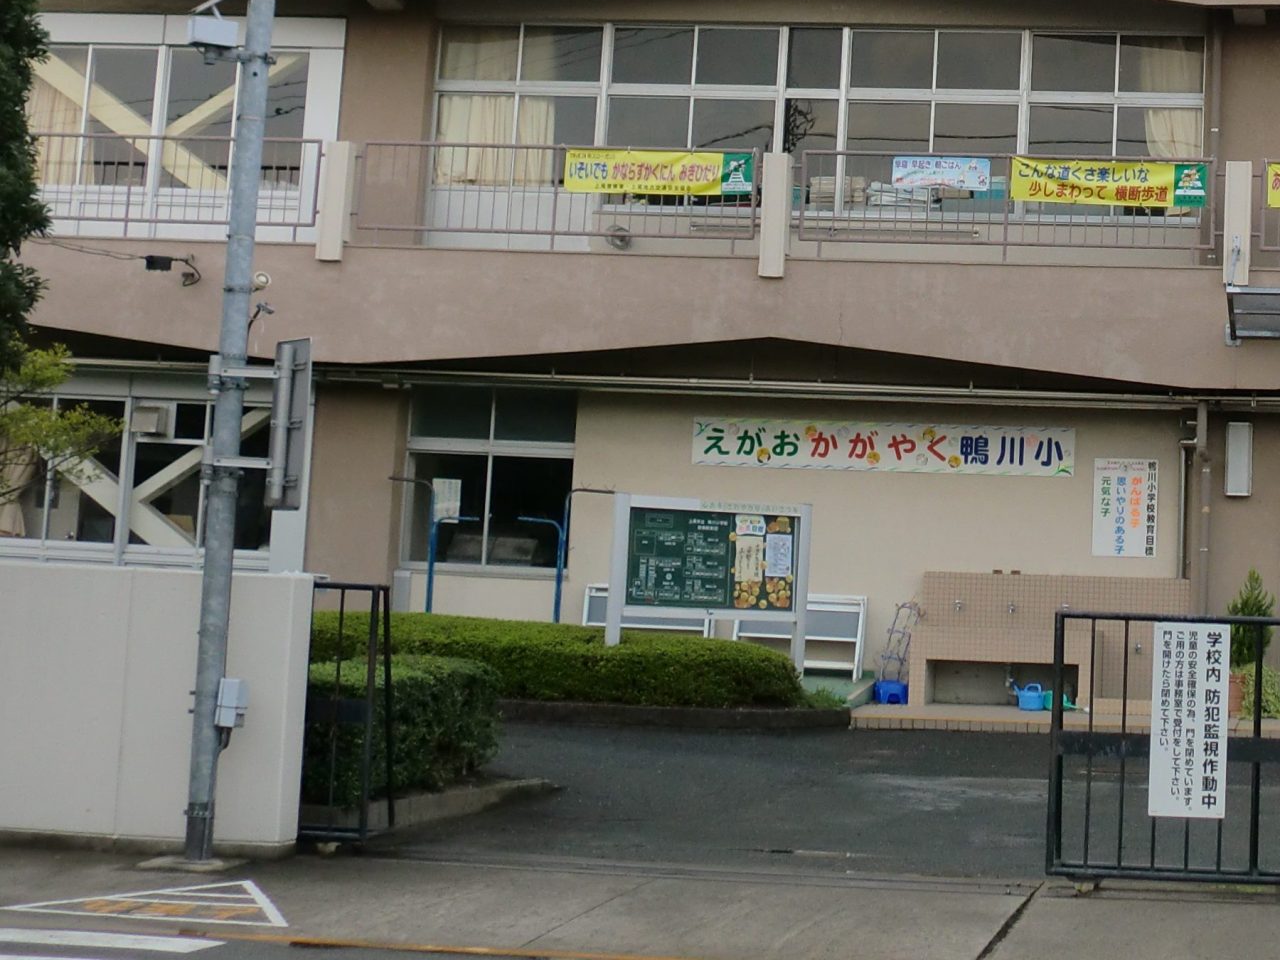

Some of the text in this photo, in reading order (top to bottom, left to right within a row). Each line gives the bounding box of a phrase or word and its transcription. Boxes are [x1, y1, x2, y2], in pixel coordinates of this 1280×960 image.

[569, 161, 720, 182] いそいでも かならずかくにん みぎひだり
[1018, 162, 1150, 183] こんな道くさ楽しいな
[1029, 181, 1107, 200] 少しまわって
[1115, 185, 1169, 202] 横断歩道
[1100, 476, 1111, 517] 元気な子
[1130, 476, 1143, 528] がんばる子
[1114, 476, 1127, 555] 思いやりのある子
